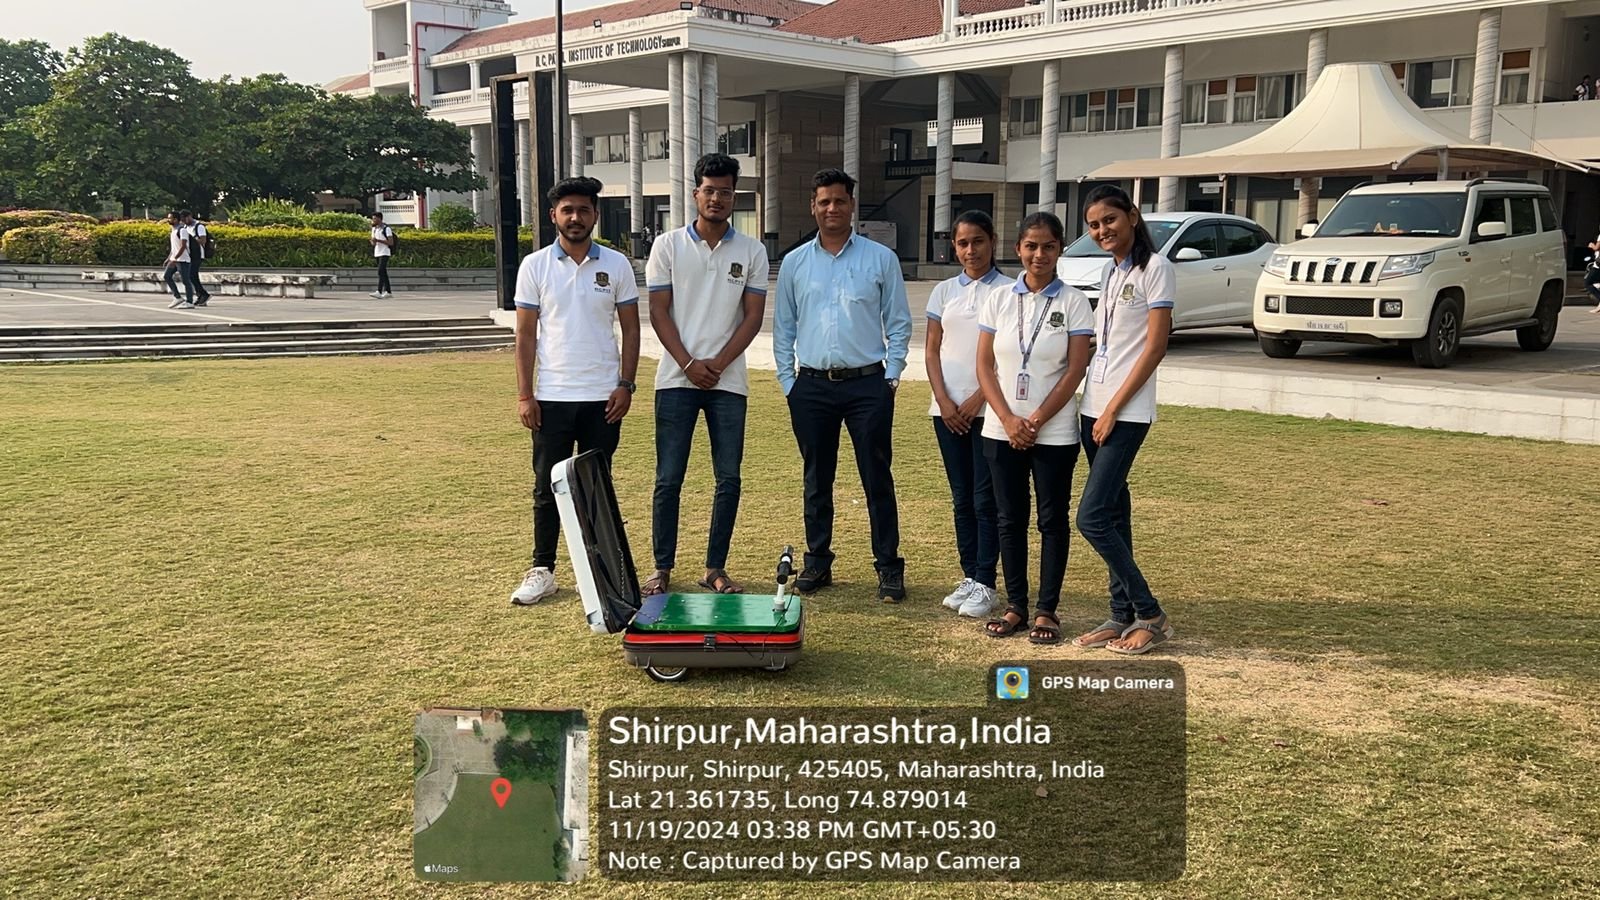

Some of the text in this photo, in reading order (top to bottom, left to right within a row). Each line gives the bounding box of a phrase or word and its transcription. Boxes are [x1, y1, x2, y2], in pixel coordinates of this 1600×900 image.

[568, 45, 603, 63] INSTITUTE
[605, 43, 614, 57] OF
[616, 35, 662, 55] TECHNOLOGY
